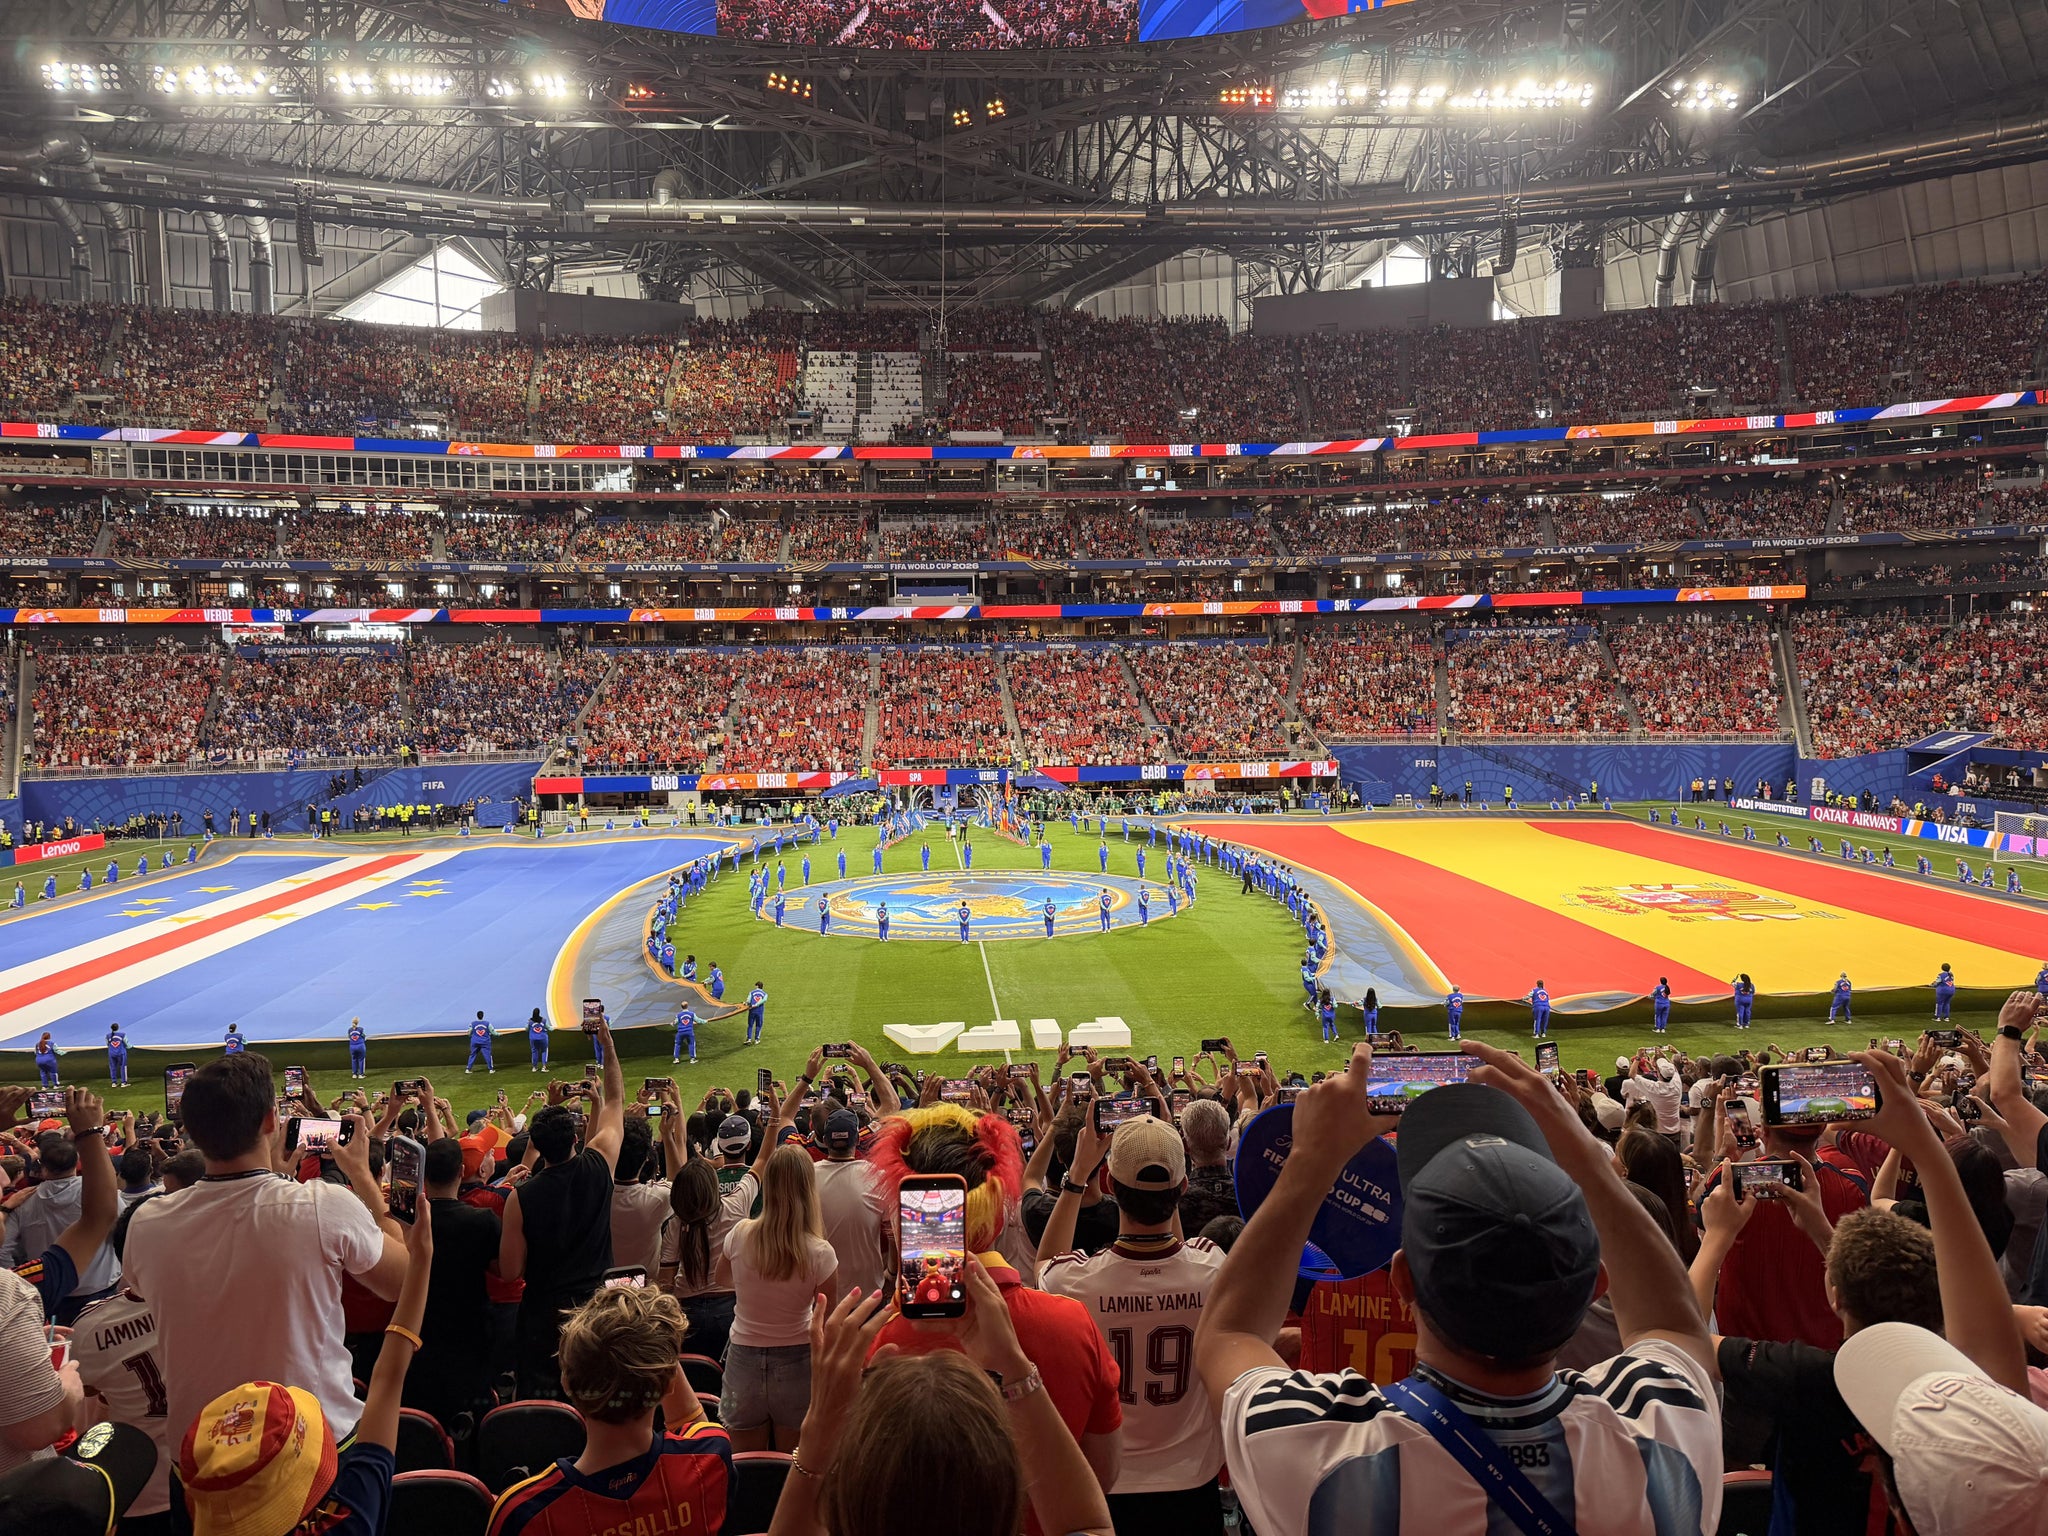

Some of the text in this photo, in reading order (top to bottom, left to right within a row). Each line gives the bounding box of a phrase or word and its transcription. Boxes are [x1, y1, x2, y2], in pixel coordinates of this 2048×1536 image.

[1816, 402, 1920, 424] SPA IN
[1654, 416, 1776, 434] CABO VERDE
[38, 424, 149, 441] SPA IN
[534, 445, 646, 458] CABO VERDE
[680, 446, 766, 458] SPA IN
[1090, 445, 1193, 457] CABO VERDE
[1226, 442, 1306, 456] SPA IN
[1752, 536, 1859, 548] FIFA WORLD CUP 2026
[1533, 546, 1595, 555] ATLANTA
[12, 558, 48, 566] 2026
[221, 561, 291, 569] ATLANTA
[1748, 586, 1772, 598] CABO
[1204, 601, 1303, 613] CABO VERDE
[1334, 597, 1418, 611] SPA IN
[99, 609, 233, 622] CABO VERDE
[273, 609, 370, 621] SPA IN
[694, 608, 799, 620] CABO VERDE
[831, 607, 912, 619] SPA IN
[339, 646, 370, 654] 2026
[1311, 762, 1329, 776] SPA
[1415, 759, 1437, 768] FIFA
[909, 773, 922, 782] SPA
[978, 771, 998, 780] VERDE
[1141, 763, 1270, 779] CABO VERDE
[422, 781, 445, 790] FIFA
[651, 773, 787, 790] CABO VERDE
[1736, 798, 1808, 816] ADI PREDICTSTREET
[1957, 803, 1977, 814] FIFA
[1813, 807, 1897, 831] QATAR AIRWAYS
[1936, 823, 1969, 845] VISA
[41, 840, 80, 858] Lenovo
[1342, 1169, 1391, 1205] ULTRA
[1335, 1189, 1361, 1207] CUP
[1099, 1291, 1203, 1313] LAMINE YAMAL
[1319, 1290, 1391, 1320] LAMINE
[1108, 1324, 1194, 1406] 19
[1432, 1409, 1449, 1425] MEX
[1487, 1464, 1503, 1480] CAN
[1536, 1518, 1552, 1536] USA
